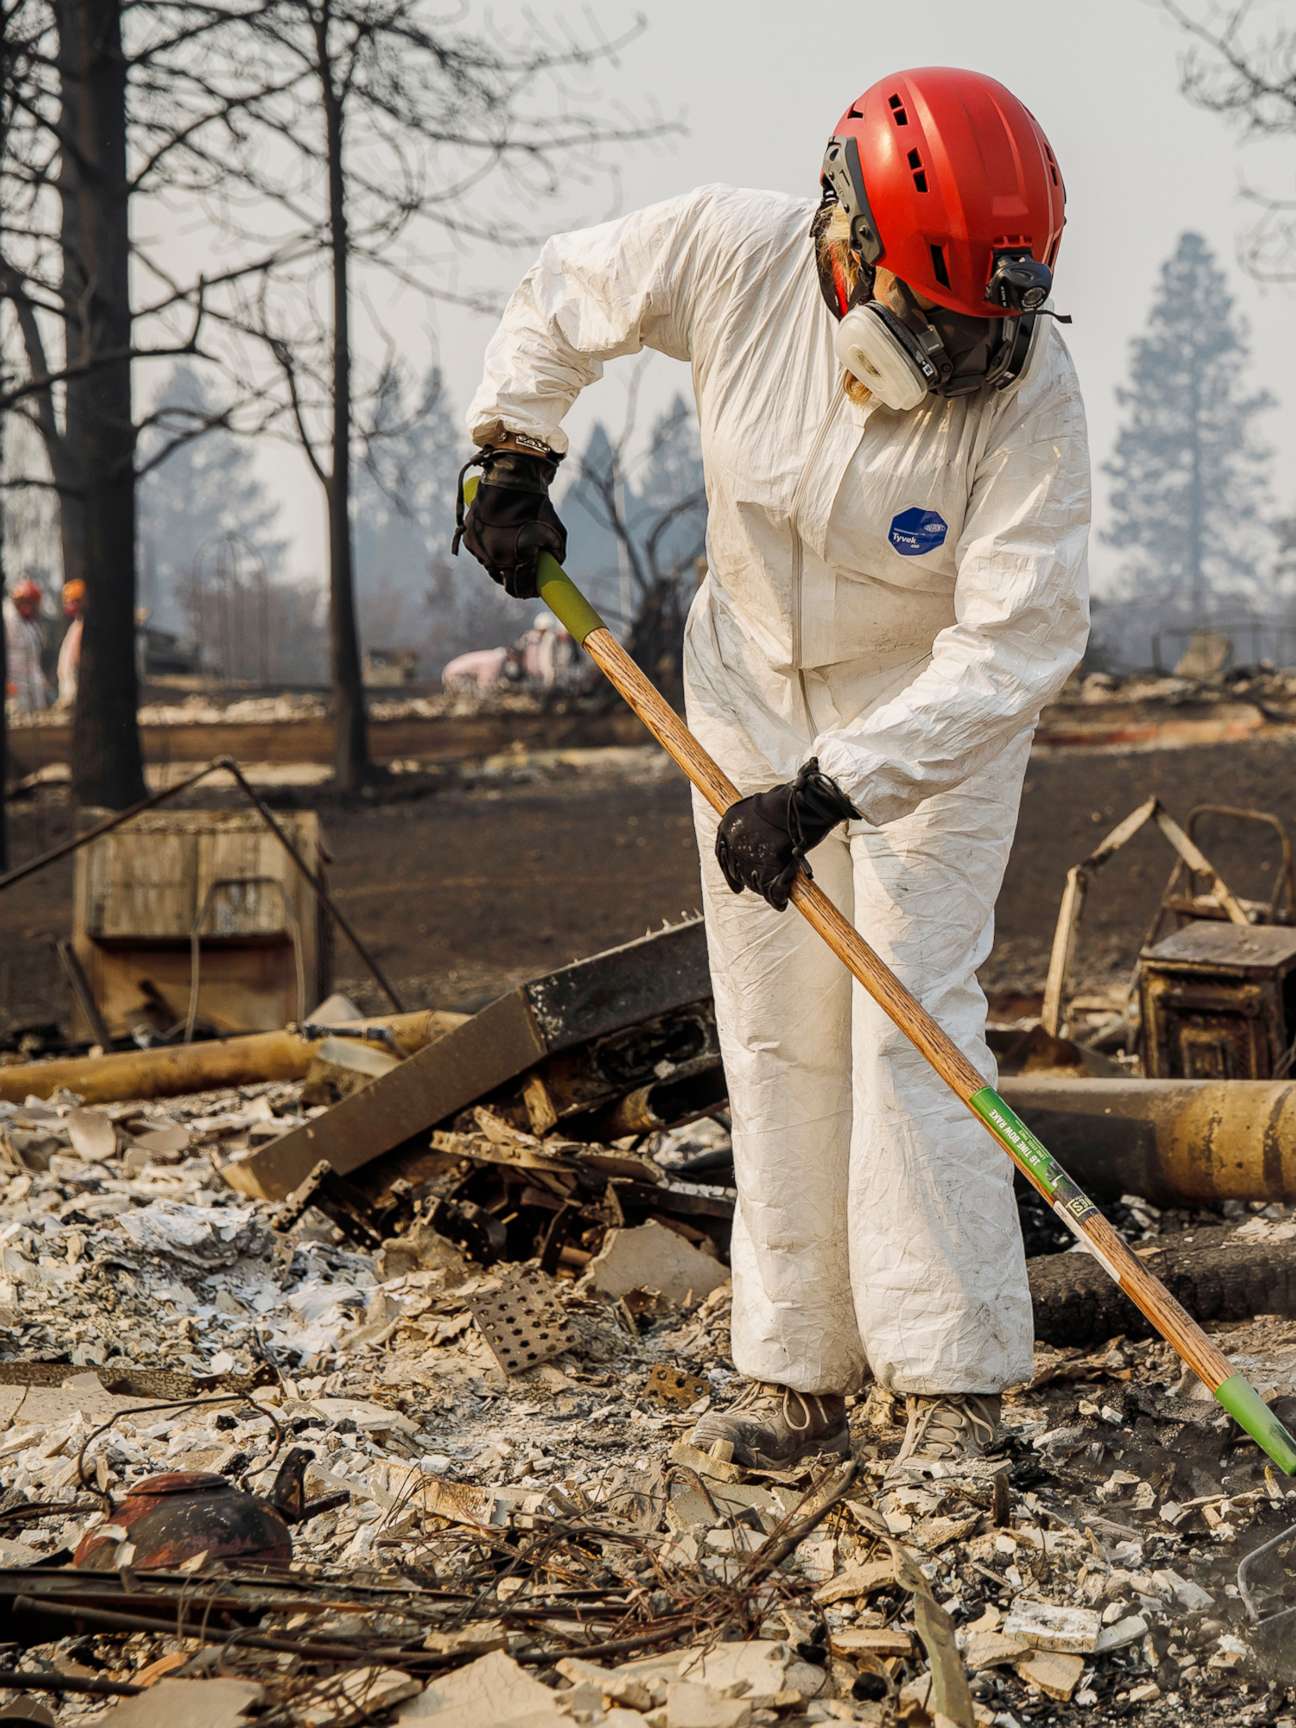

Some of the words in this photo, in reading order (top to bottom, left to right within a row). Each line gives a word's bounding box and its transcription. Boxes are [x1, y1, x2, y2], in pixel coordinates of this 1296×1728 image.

[892, 532, 917, 544] Tyvek
[988, 1108, 1007, 1129] RAKE
[1002, 1125, 1020, 1144] BOW
[1016, 1140, 1033, 1157] TINE
[1028, 1154, 1040, 1166] 16
